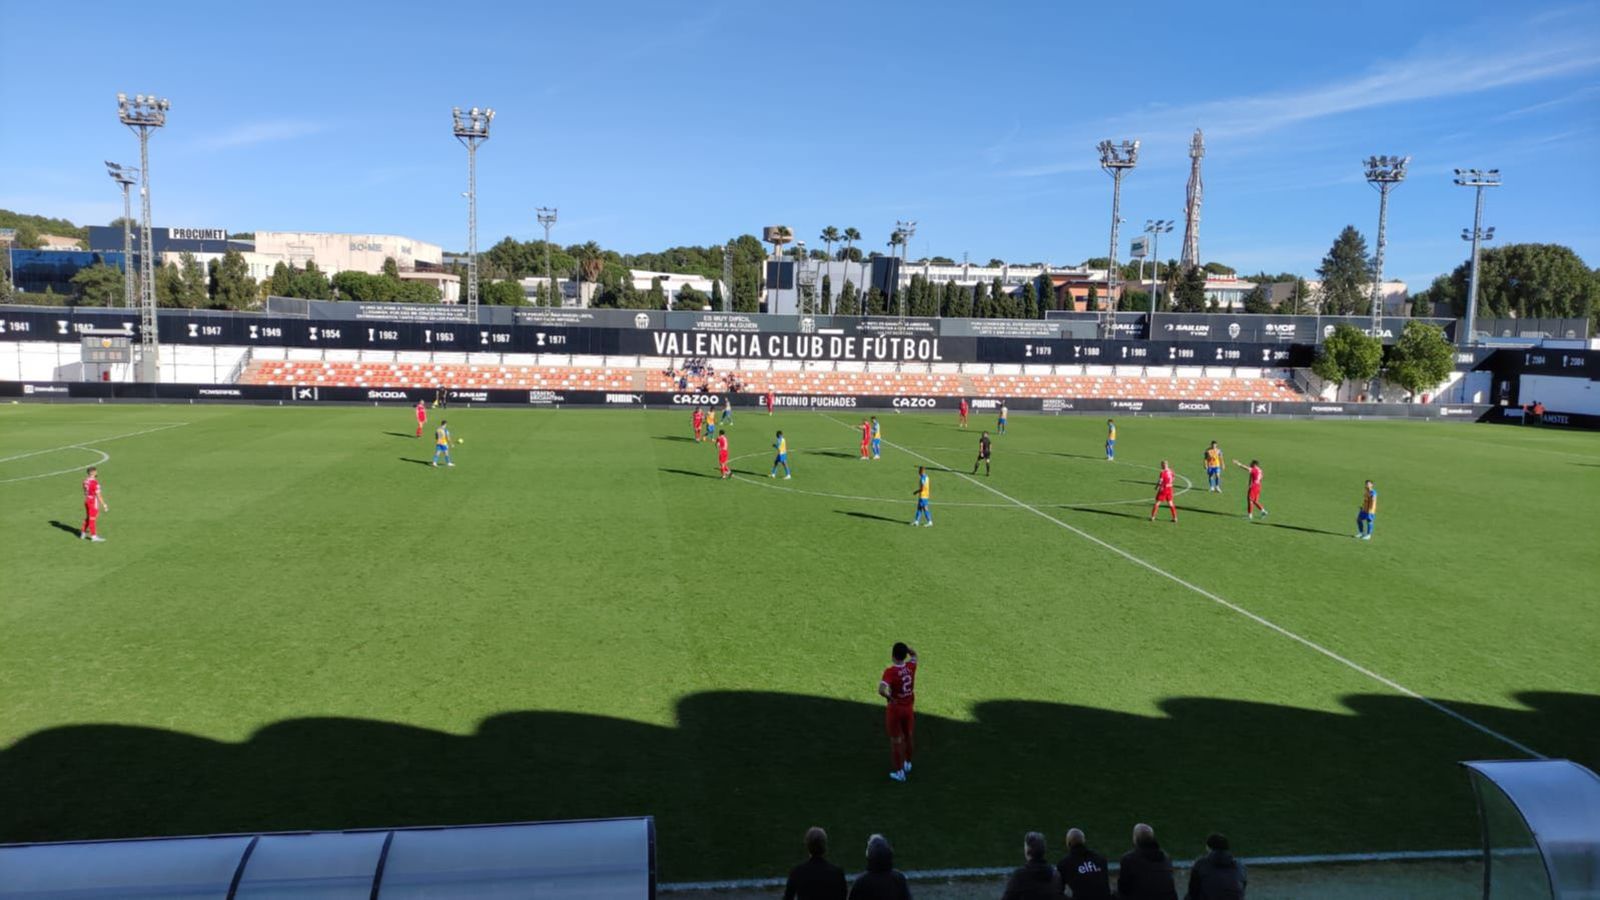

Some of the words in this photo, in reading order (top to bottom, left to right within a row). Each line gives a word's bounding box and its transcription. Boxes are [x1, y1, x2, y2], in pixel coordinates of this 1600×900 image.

[173, 229, 223, 239] PROCUMET
[9, 321, 30, 332] 1941
[202, 325, 222, 336] 1947
[262, 327, 282, 337] 1949
[321, 329, 341, 339] 1954
[379, 331, 398, 340] 1962
[436, 332, 454, 342] 1963
[492, 333, 511, 343] 1967
[549, 335, 566, 344] 1971
[653, 331, 762, 356] VALENCIA
[768, 335, 824, 358] CLUB
[830, 337, 856, 359] DE
[862, 334, 942, 360] FÚTBOL
[368, 390, 407, 399] ŠKODA
[606, 393, 633, 403] PUMA
[673, 394, 719, 404] CAZOO
[811, 397, 856, 407] PUCHADES
[893, 398, 936, 408] CAZOO
[902, 674, 912, 692] 2
